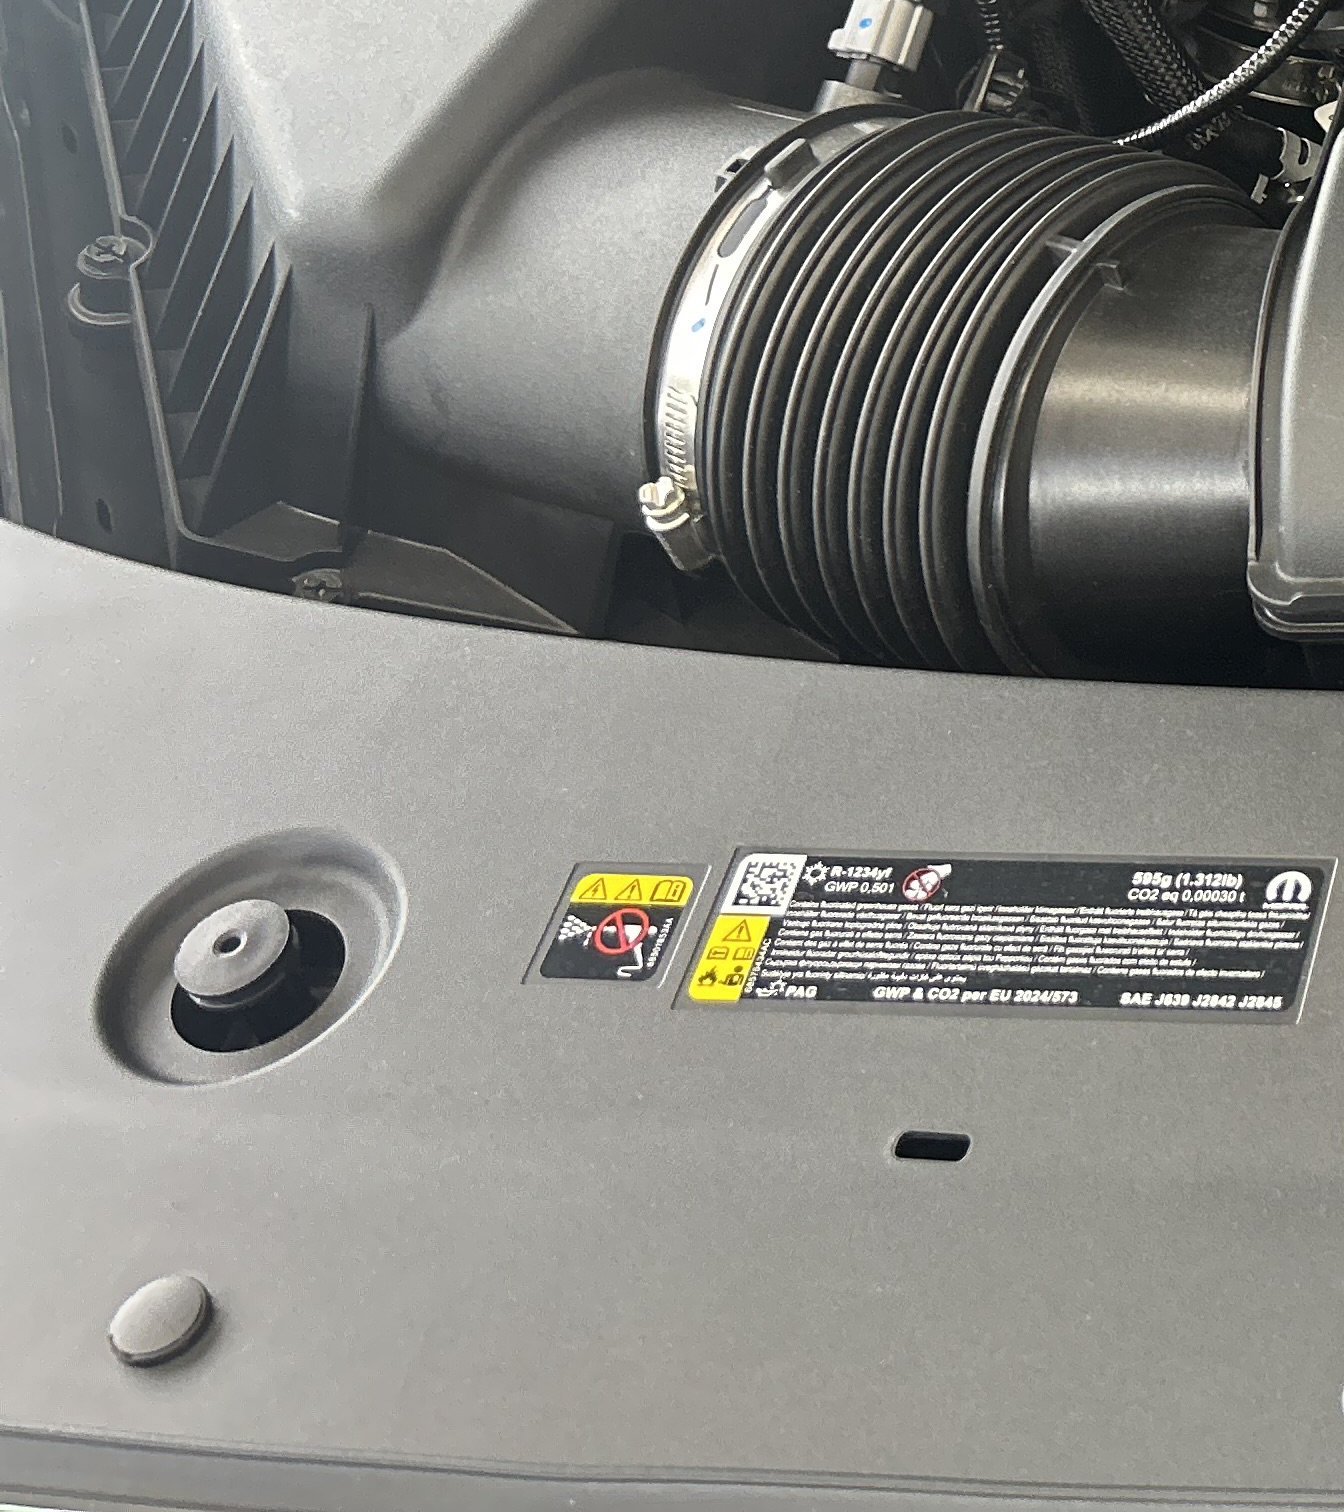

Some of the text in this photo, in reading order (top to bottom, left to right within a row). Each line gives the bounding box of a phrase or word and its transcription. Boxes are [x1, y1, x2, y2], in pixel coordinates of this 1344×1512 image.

[829, 864, 893, 881] R-1234yf
[823, 880, 859, 893] GWP
[1127, 887, 1160, 901] CO2
[784, 984, 818, 1000] PAG
[872, 986, 1079, 1006] GWP & CO2 per EU 2024/573
[1119, 991, 1152, 1006] SAE
